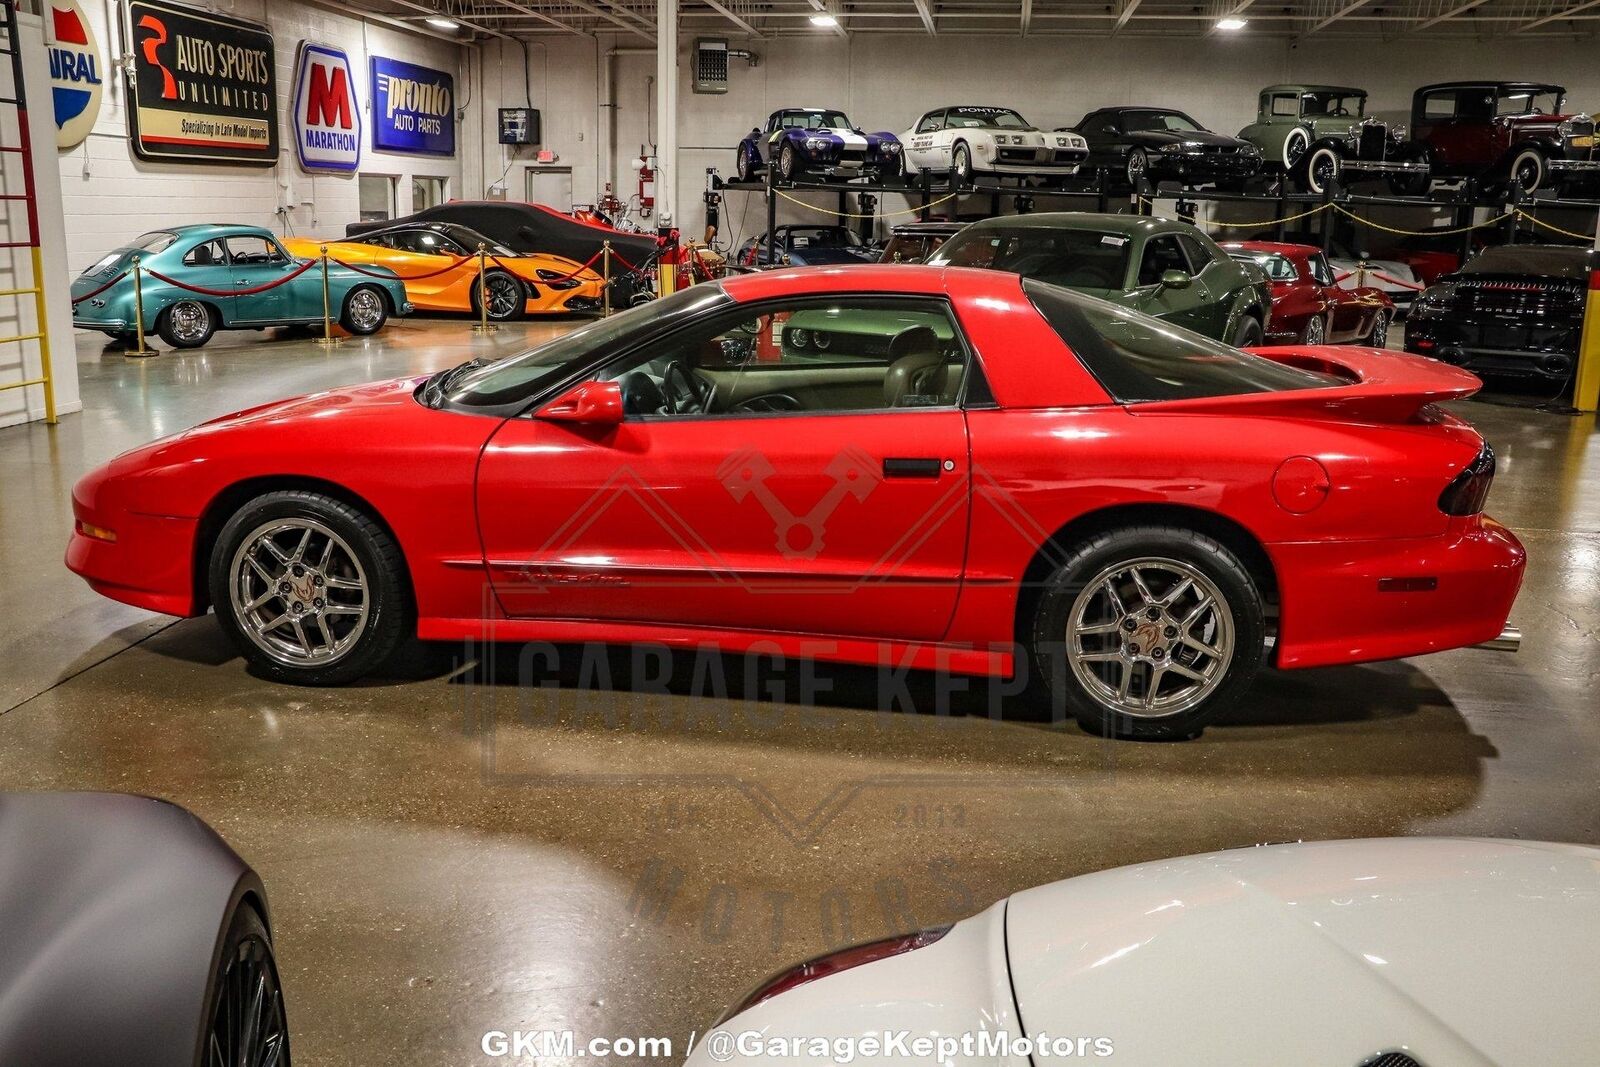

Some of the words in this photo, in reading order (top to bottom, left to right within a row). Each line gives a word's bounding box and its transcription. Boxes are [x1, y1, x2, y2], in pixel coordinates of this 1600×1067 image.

[176, 34, 215, 76] AUTO
[217, 43, 269, 85] SPORTS
[178, 80, 269, 111] UNLIMITED
[307, 62, 352, 130] M
[387, 75, 450, 119] pronto
[181, 118, 214, 137] Specializing
[221, 122, 232, 137] Late
[233, 124, 248, 138] Model
[394, 113, 414, 132] AUTO
[418, 116, 441, 135] PARTS
[306, 129, 356, 152] MARATHON
[1475, 307, 1544, 315] PORSCHE
